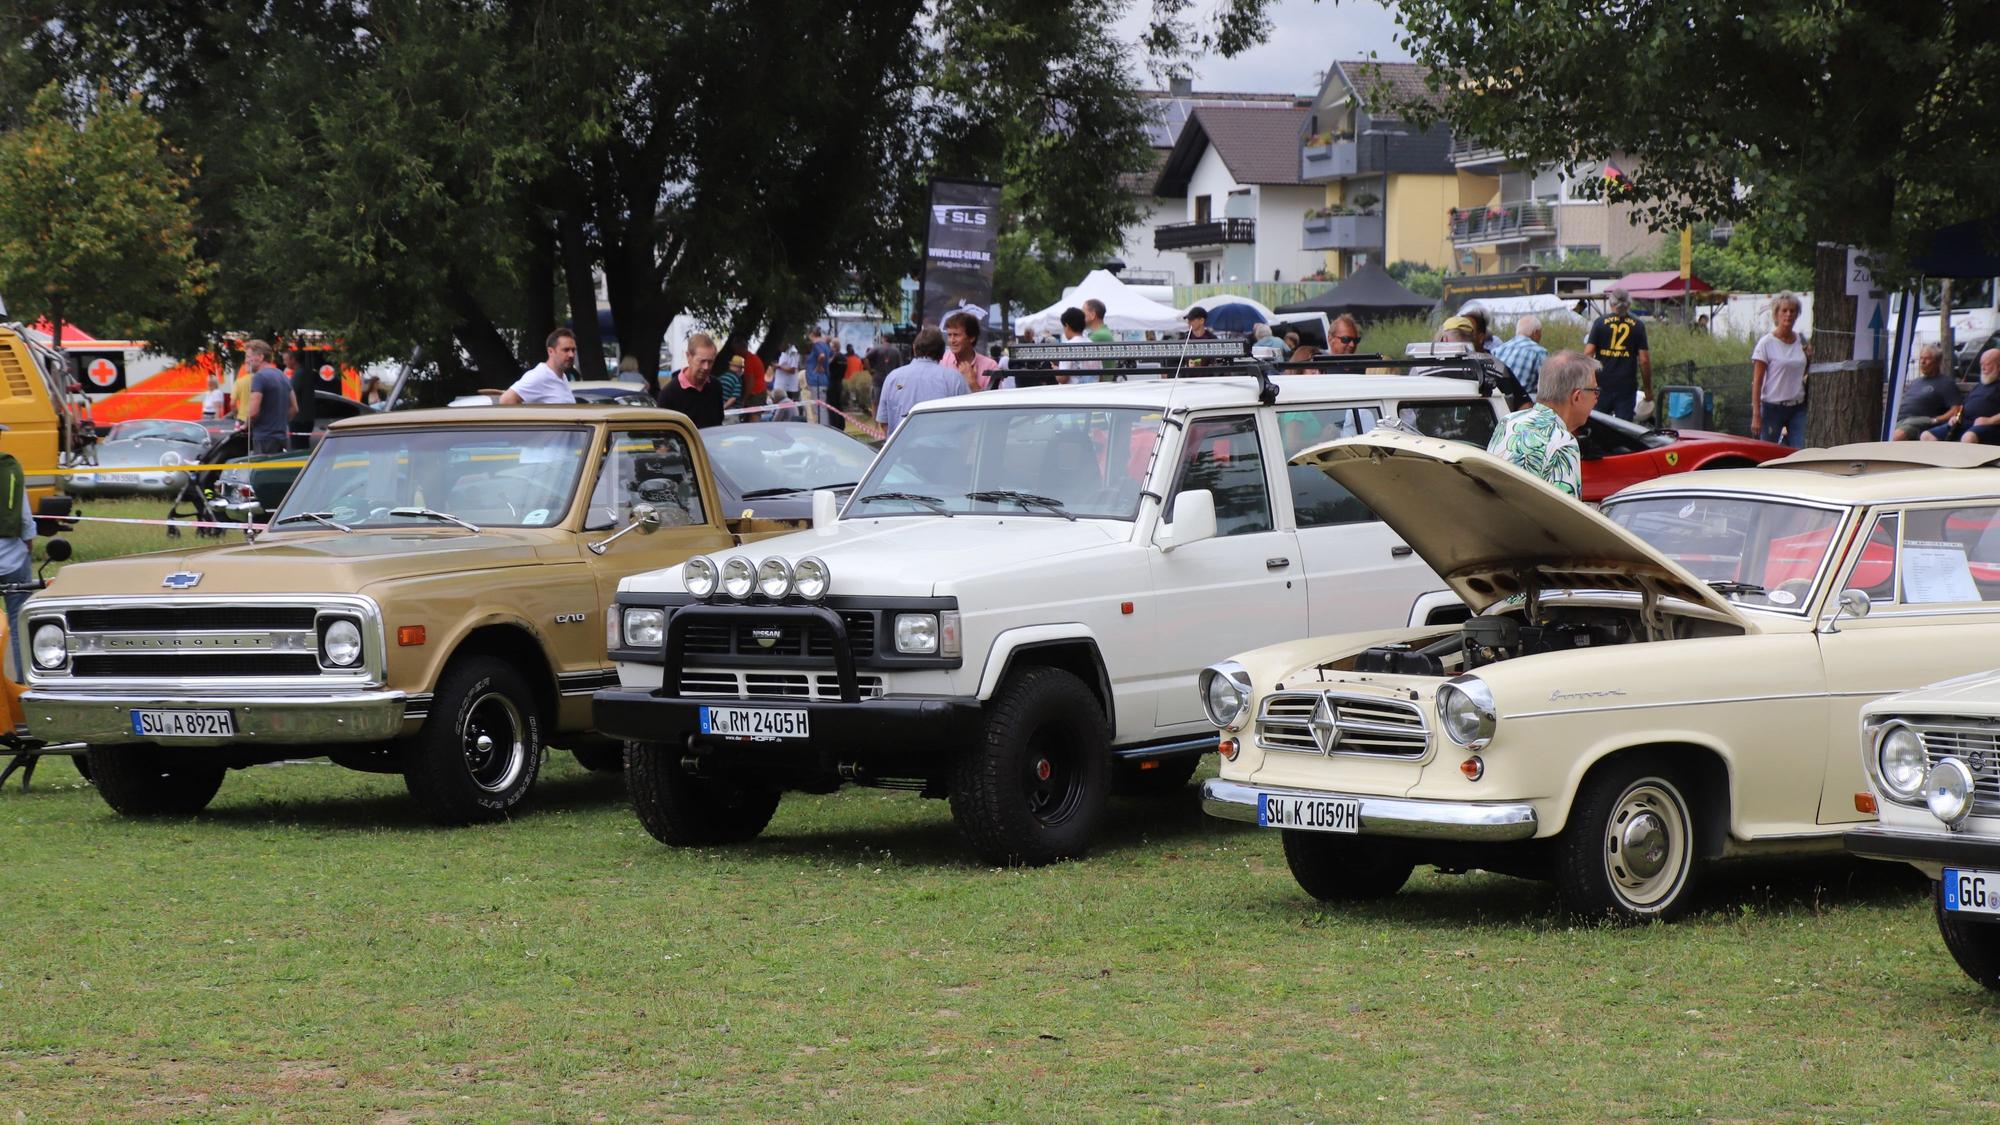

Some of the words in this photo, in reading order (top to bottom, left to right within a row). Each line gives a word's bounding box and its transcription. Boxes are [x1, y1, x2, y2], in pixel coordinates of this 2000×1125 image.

[952, 211, 987, 225] SLS
[928, 247, 991, 261] WWW.SLS-CLUB.DE
[1610, 322, 1630, 350] 12
[556, 613, 585, 623] C/10
[110, 638, 264, 647] CHEVROLET
[752, 630, 781, 638] NISSAN
[141, 713, 164, 733] SU
[174, 714, 185, 734] A
[187, 714, 231, 734] 892H
[710, 710, 720, 731] K
[729, 711, 750, 732] RM
[1267, 798, 1284, 824] SU
[1294, 800, 1303, 825] K
[1307, 801, 1356, 829] 1059H
[1959, 876, 1986, 907] GG
